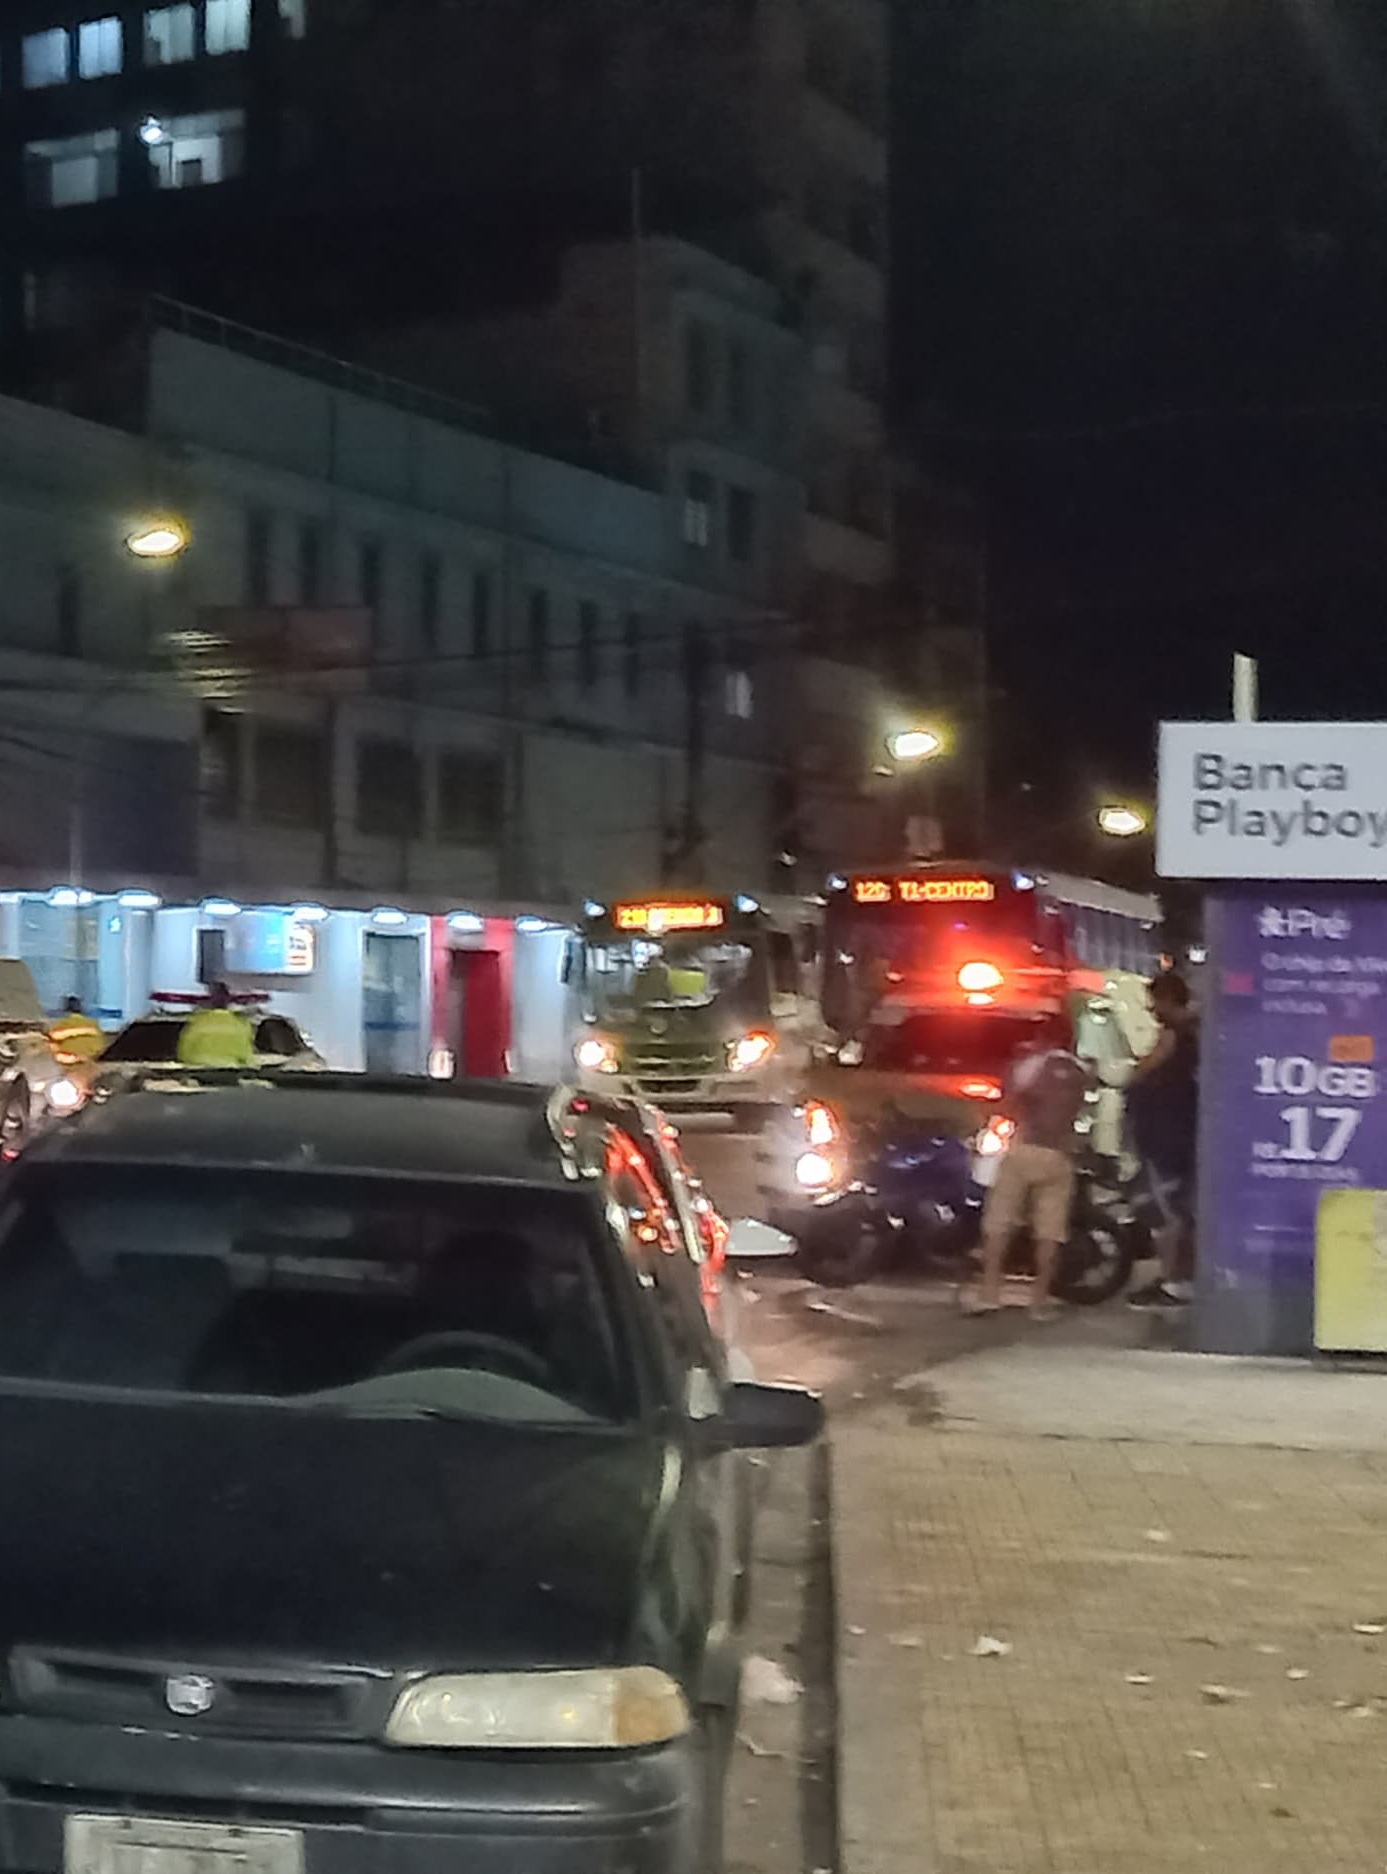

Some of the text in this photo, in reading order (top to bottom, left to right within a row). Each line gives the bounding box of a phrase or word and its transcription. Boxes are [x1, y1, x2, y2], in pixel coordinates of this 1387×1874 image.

[1193, 752, 1347, 791] Banca
[1192, 797, 1387, 848] Playboy
[1253, 1056, 1378, 1098] 10GB
[1280, 1106, 1363, 1161] 17
